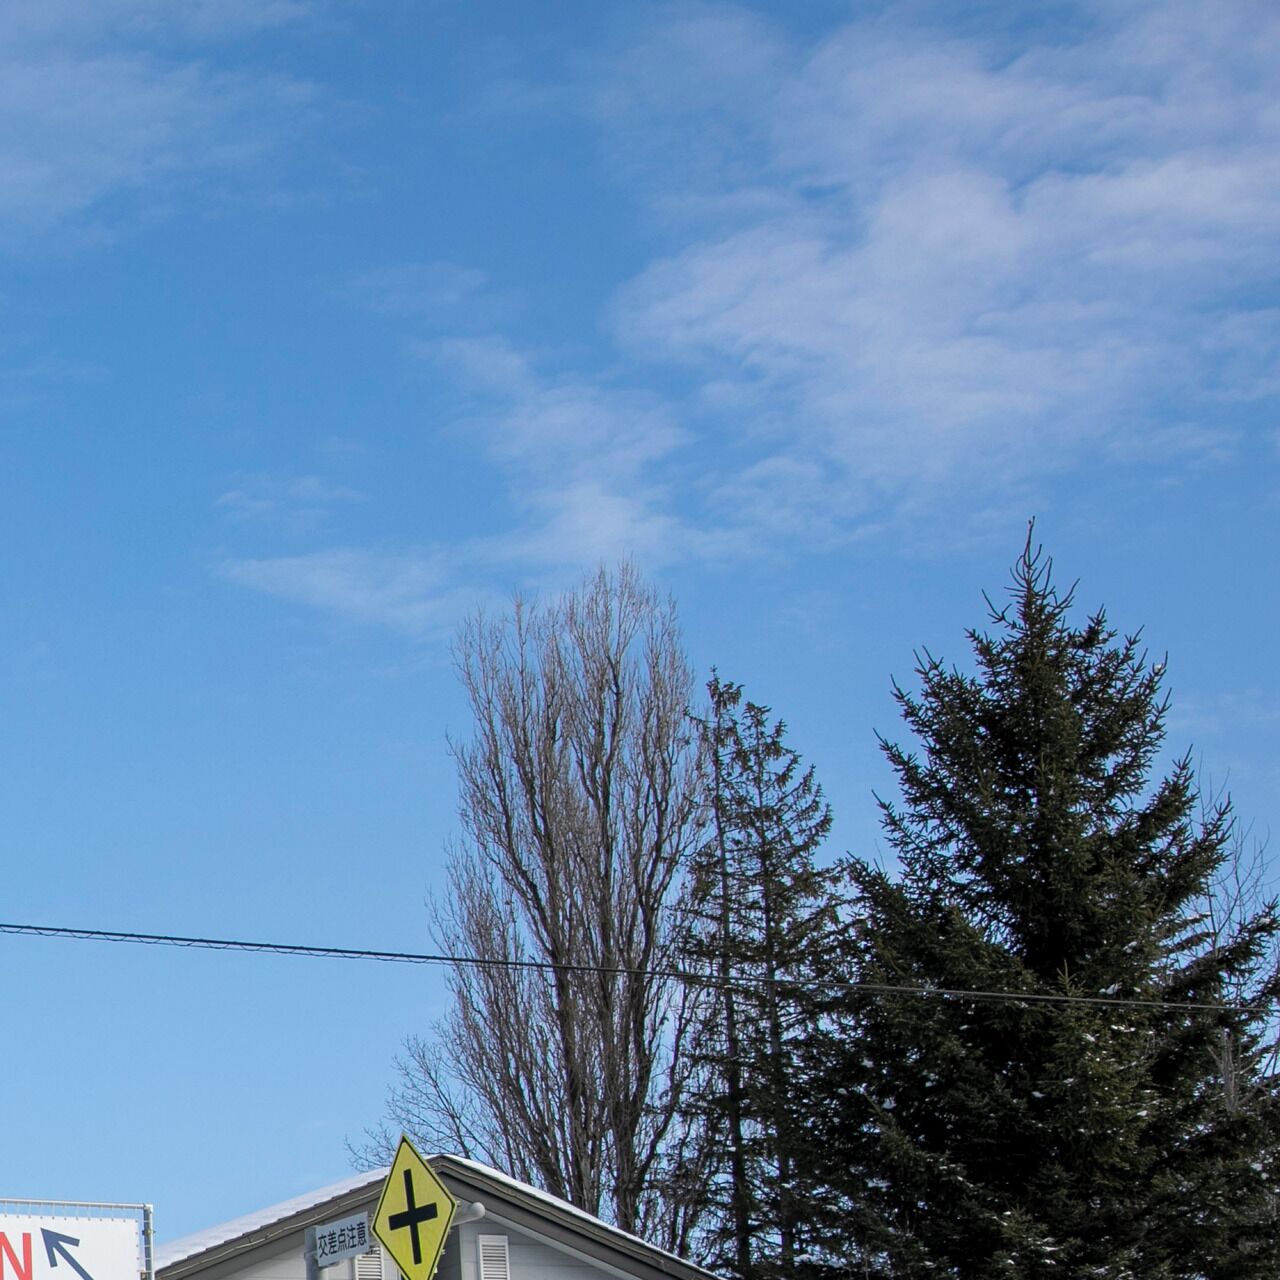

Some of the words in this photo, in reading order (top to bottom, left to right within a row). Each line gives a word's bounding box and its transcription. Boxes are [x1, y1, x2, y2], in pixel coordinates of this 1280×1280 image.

[317, 1221, 367, 1258] 交差点注意
